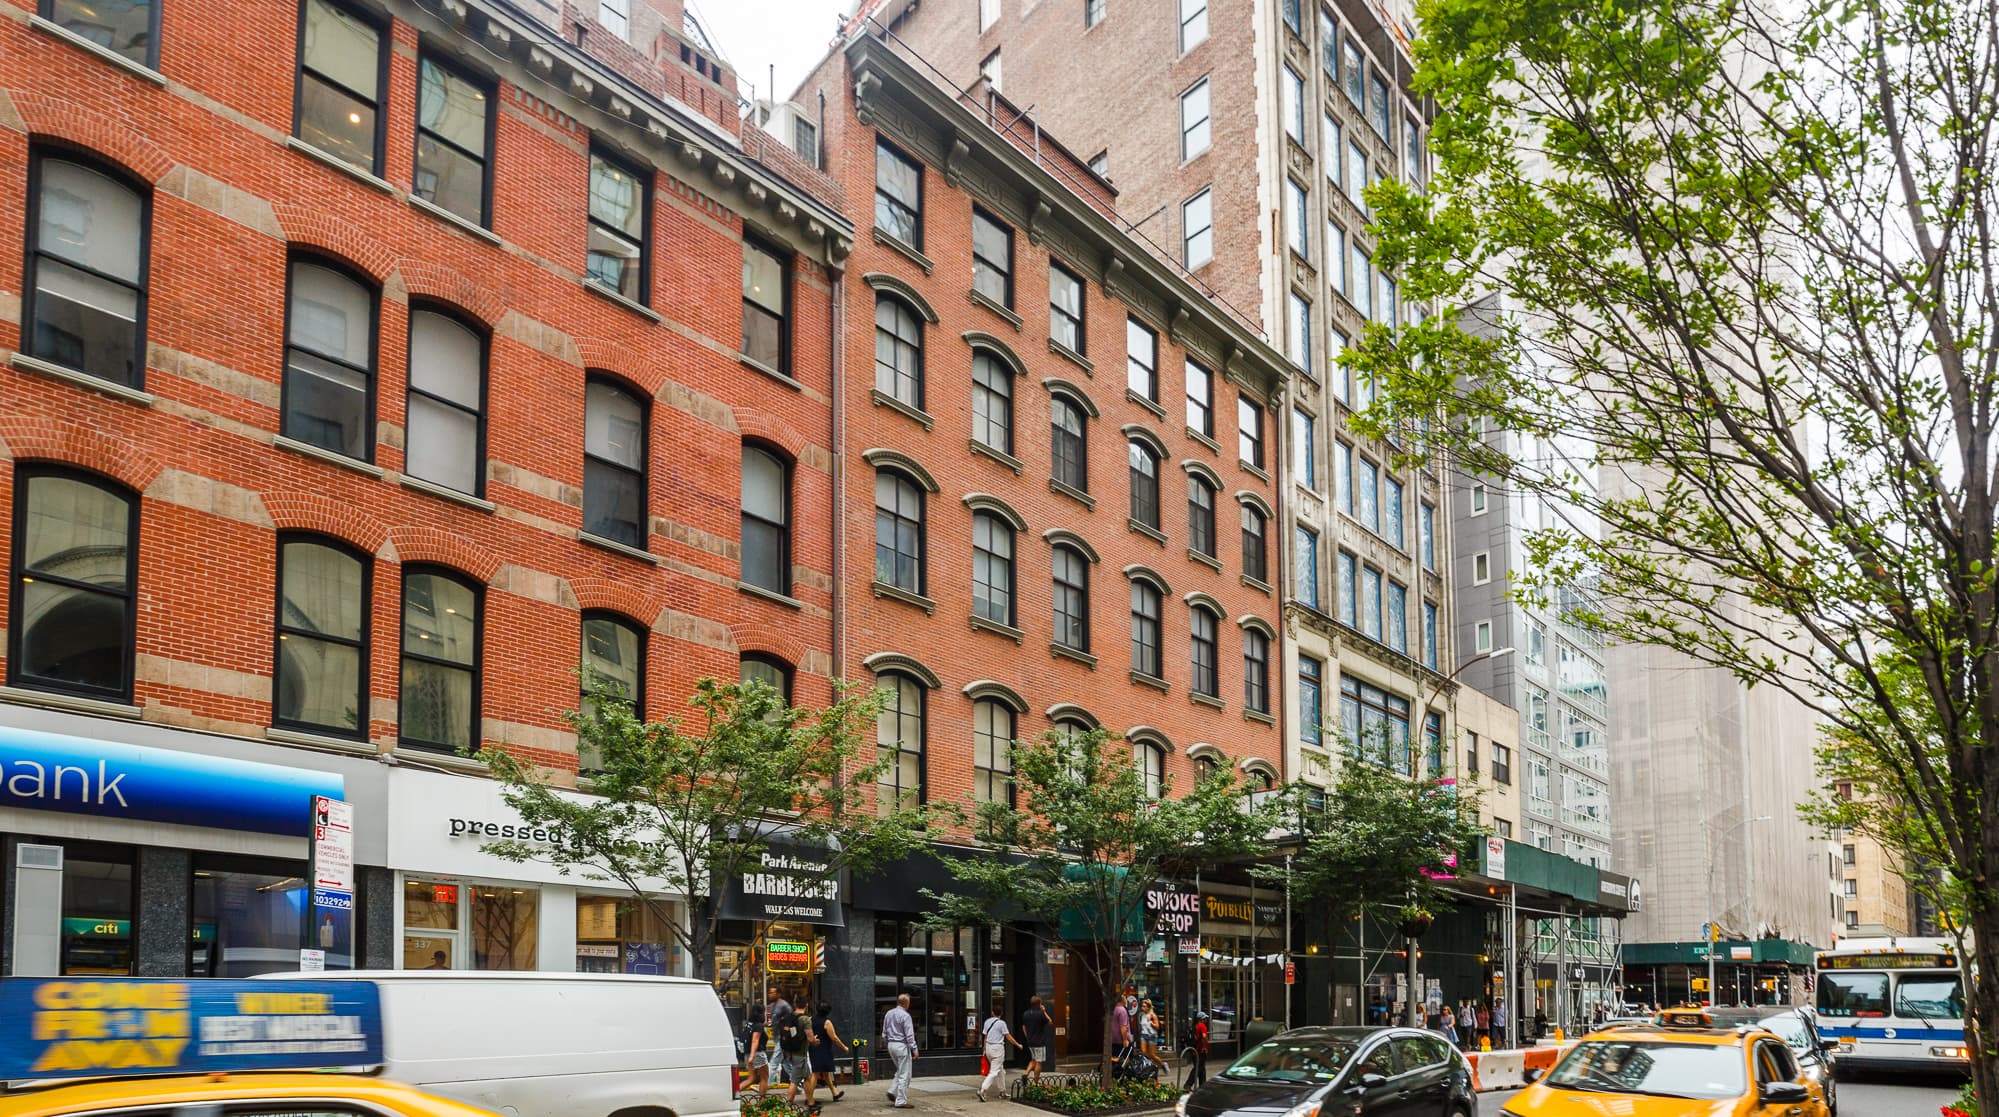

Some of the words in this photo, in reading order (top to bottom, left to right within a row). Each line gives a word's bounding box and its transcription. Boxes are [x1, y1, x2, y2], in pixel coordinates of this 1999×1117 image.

[0, 759, 128, 807] ank
[449, 817, 563, 844] pressed
[761, 852, 789, 869] Park
[794, 906, 823, 918] WELCOME
[1146, 890, 1200, 912] SMOKE
[93, 923, 119, 935] citi
[770, 943, 791, 953] BARBER
[791, 944, 807, 953] SHOP
[33, 982, 190, 1009] COME
[30, 1039, 190, 1072] AWAY
